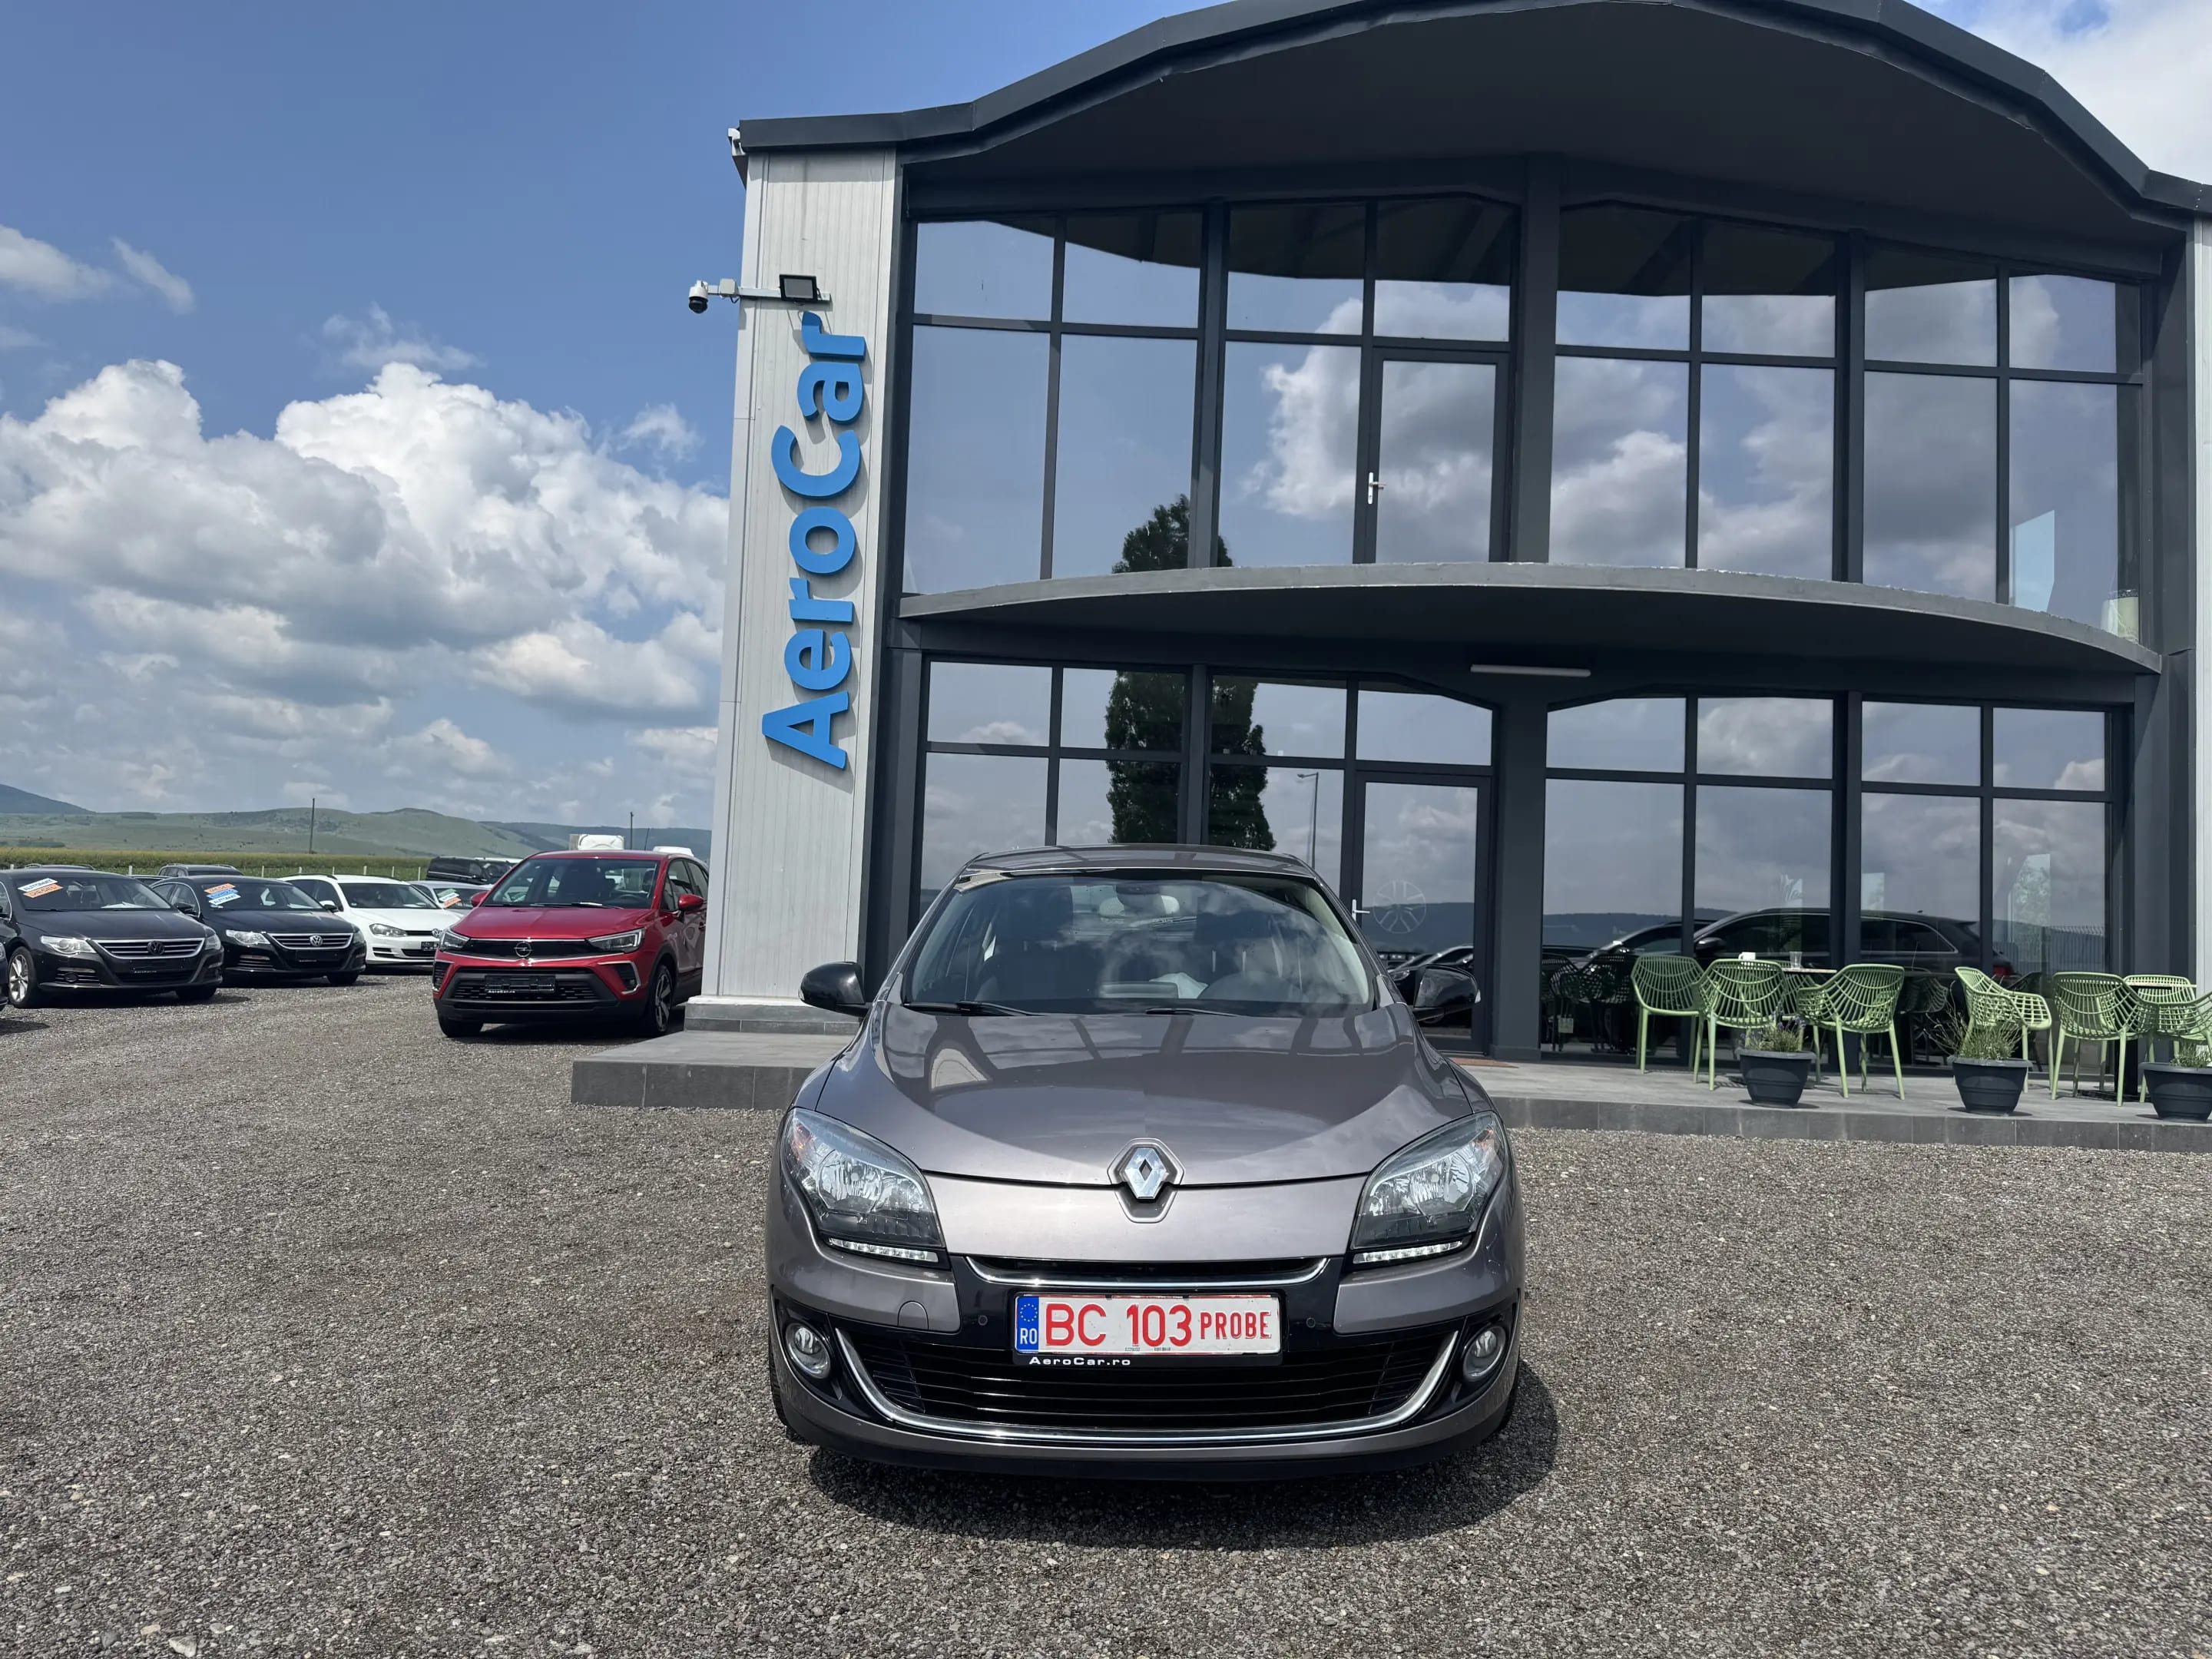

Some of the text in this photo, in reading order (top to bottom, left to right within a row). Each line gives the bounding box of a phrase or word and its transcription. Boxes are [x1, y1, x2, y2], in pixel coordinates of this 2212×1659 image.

[762, 310, 866, 770] AeroCar
[1020, 1328, 1037, 1345] RO
[1046, 1303, 1272, 1346] BC 103 PROBE
[1028, 1356, 1131, 1366] AeroCar.ro
